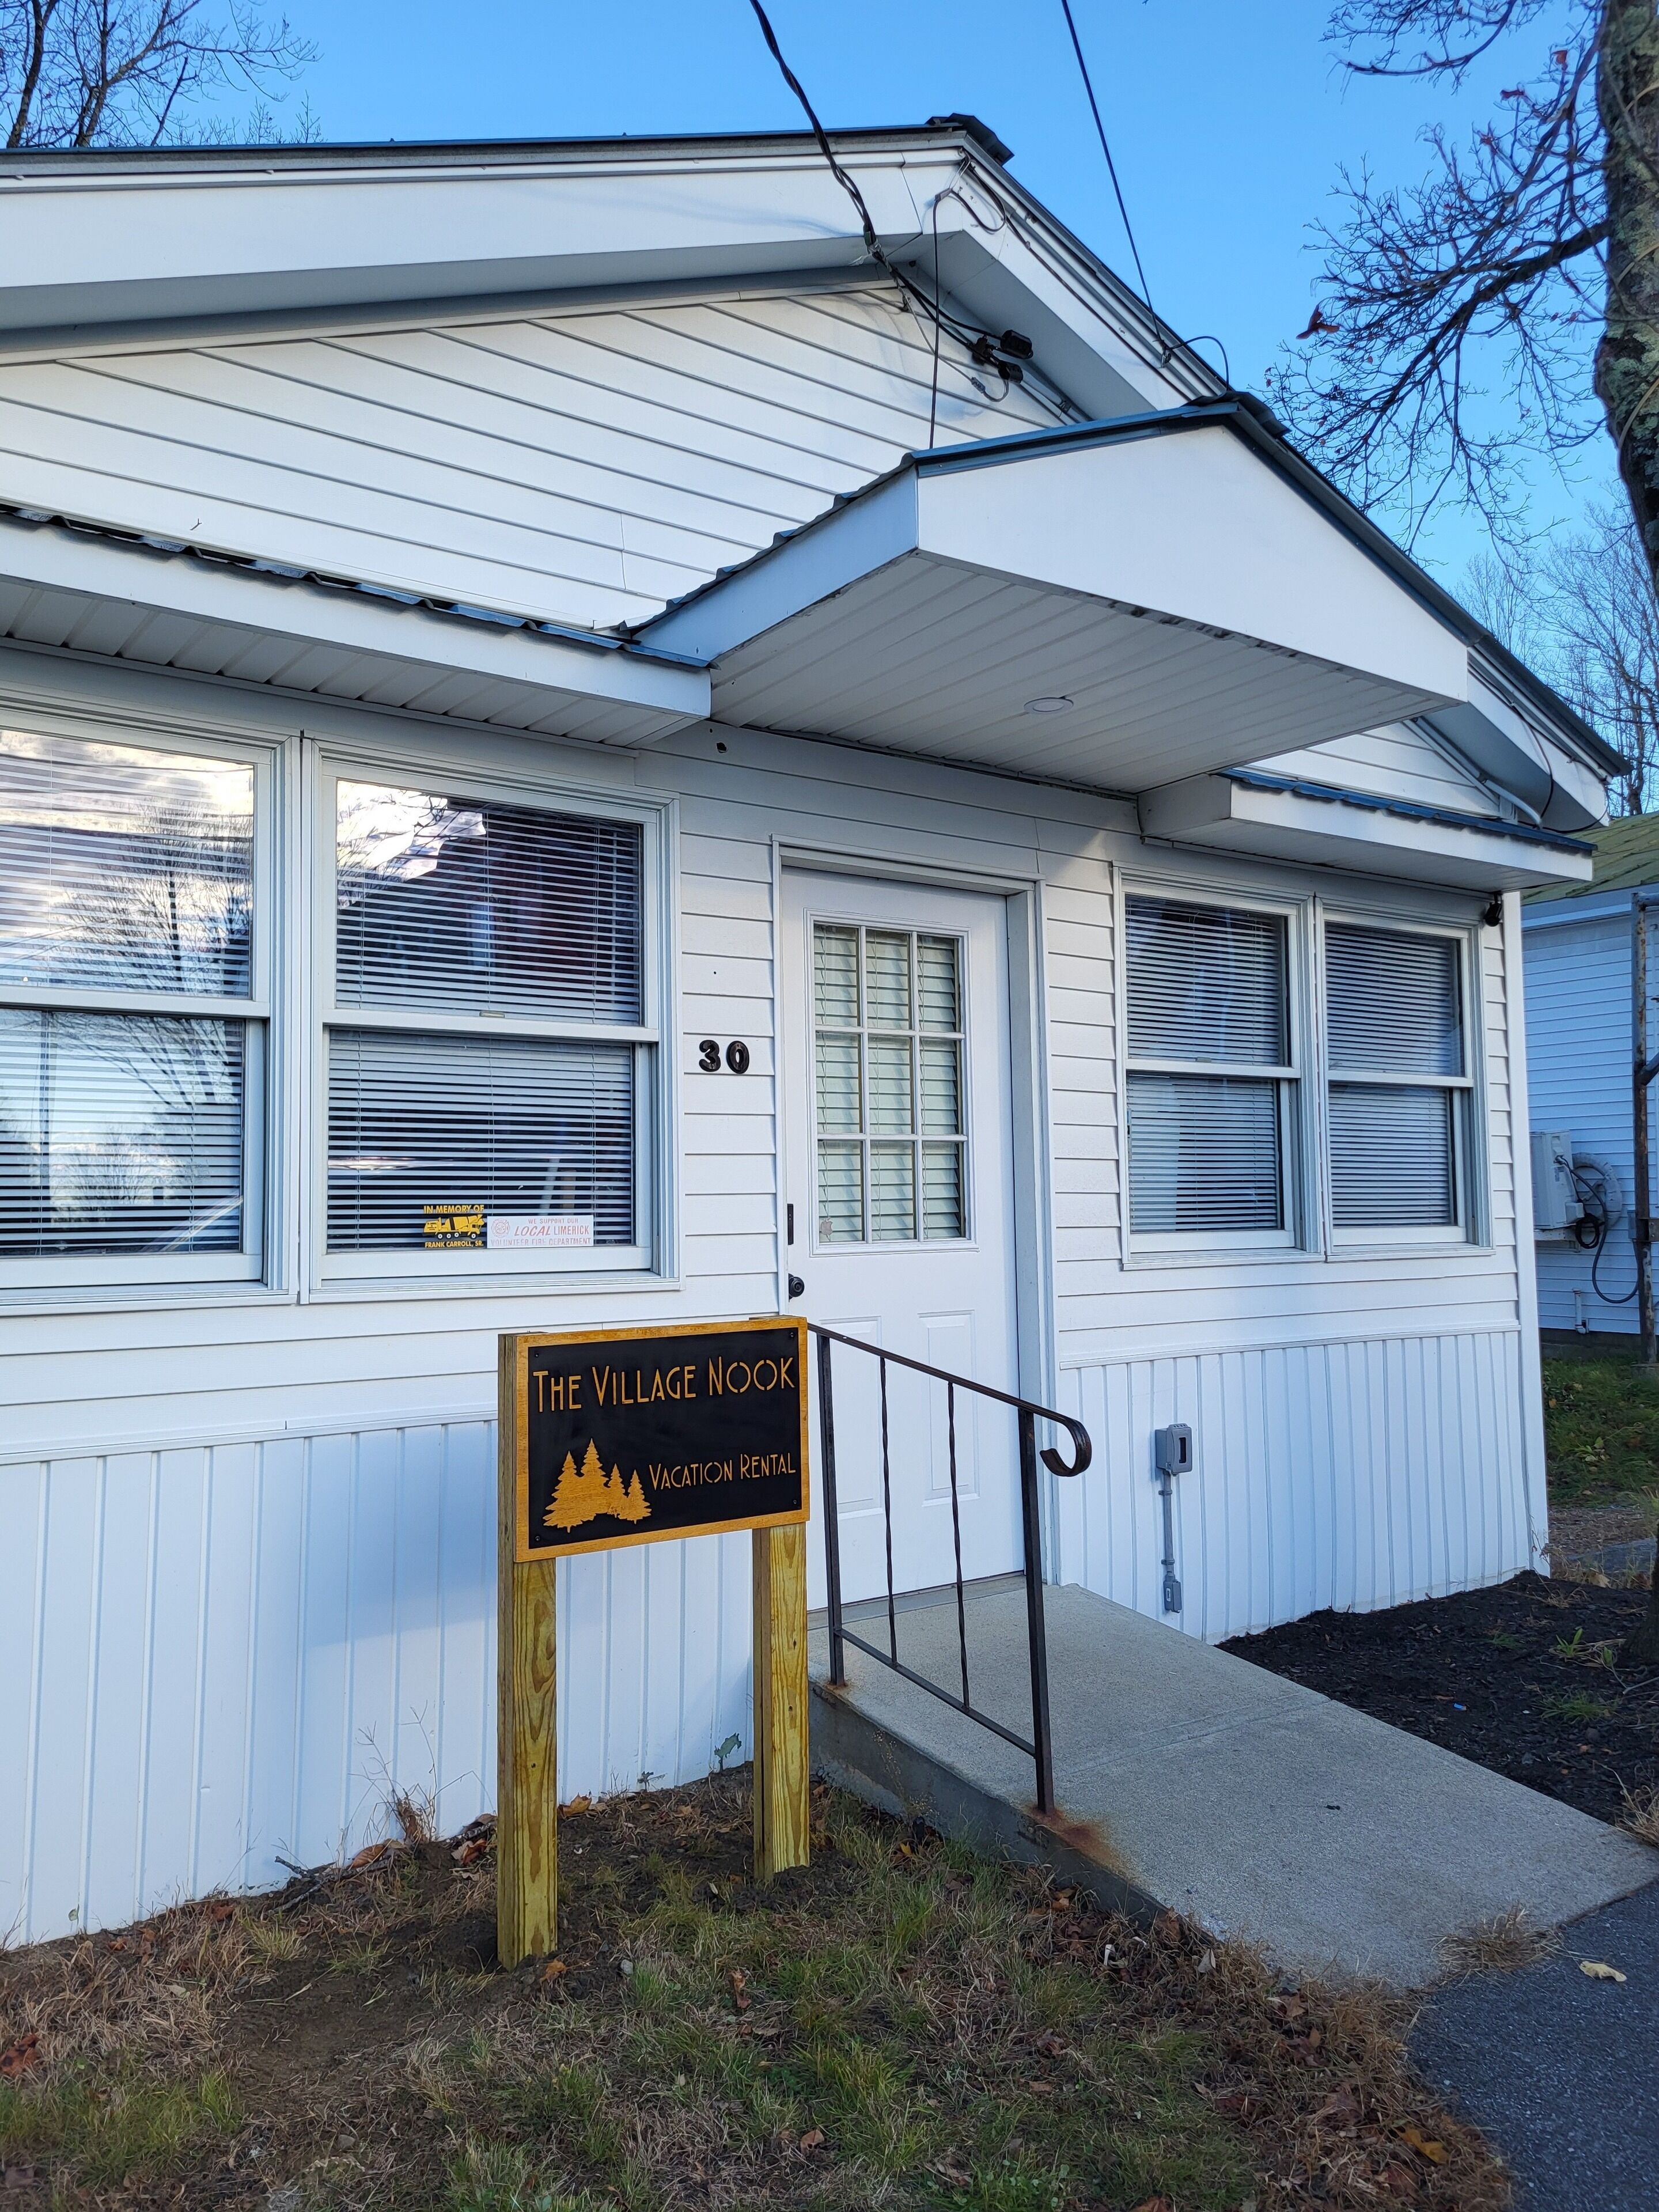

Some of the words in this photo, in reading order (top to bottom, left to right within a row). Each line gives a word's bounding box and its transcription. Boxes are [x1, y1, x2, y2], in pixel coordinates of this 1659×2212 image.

[699, 1039, 750, 1074] 30
[423, 1205, 434, 1214] IN
[436, 1205, 472, 1214] MEMORY
[473, 1205, 484, 1213] OF
[514, 1225, 551, 1236] LOCAL
[554, 1225, 590, 1236] LIMERICK
[446, 1240, 474, 1248] CARROLL,
[548, 1237, 592, 1246] DEPARTMENT
[533, 1370, 582, 1412] THE
[592, 1365, 696, 1407] VILLAGE
[709, 1356, 796, 1396] NOOK
[649, 1460, 733, 1490] VACATION
[740, 1452, 796, 1480] RENTAL
